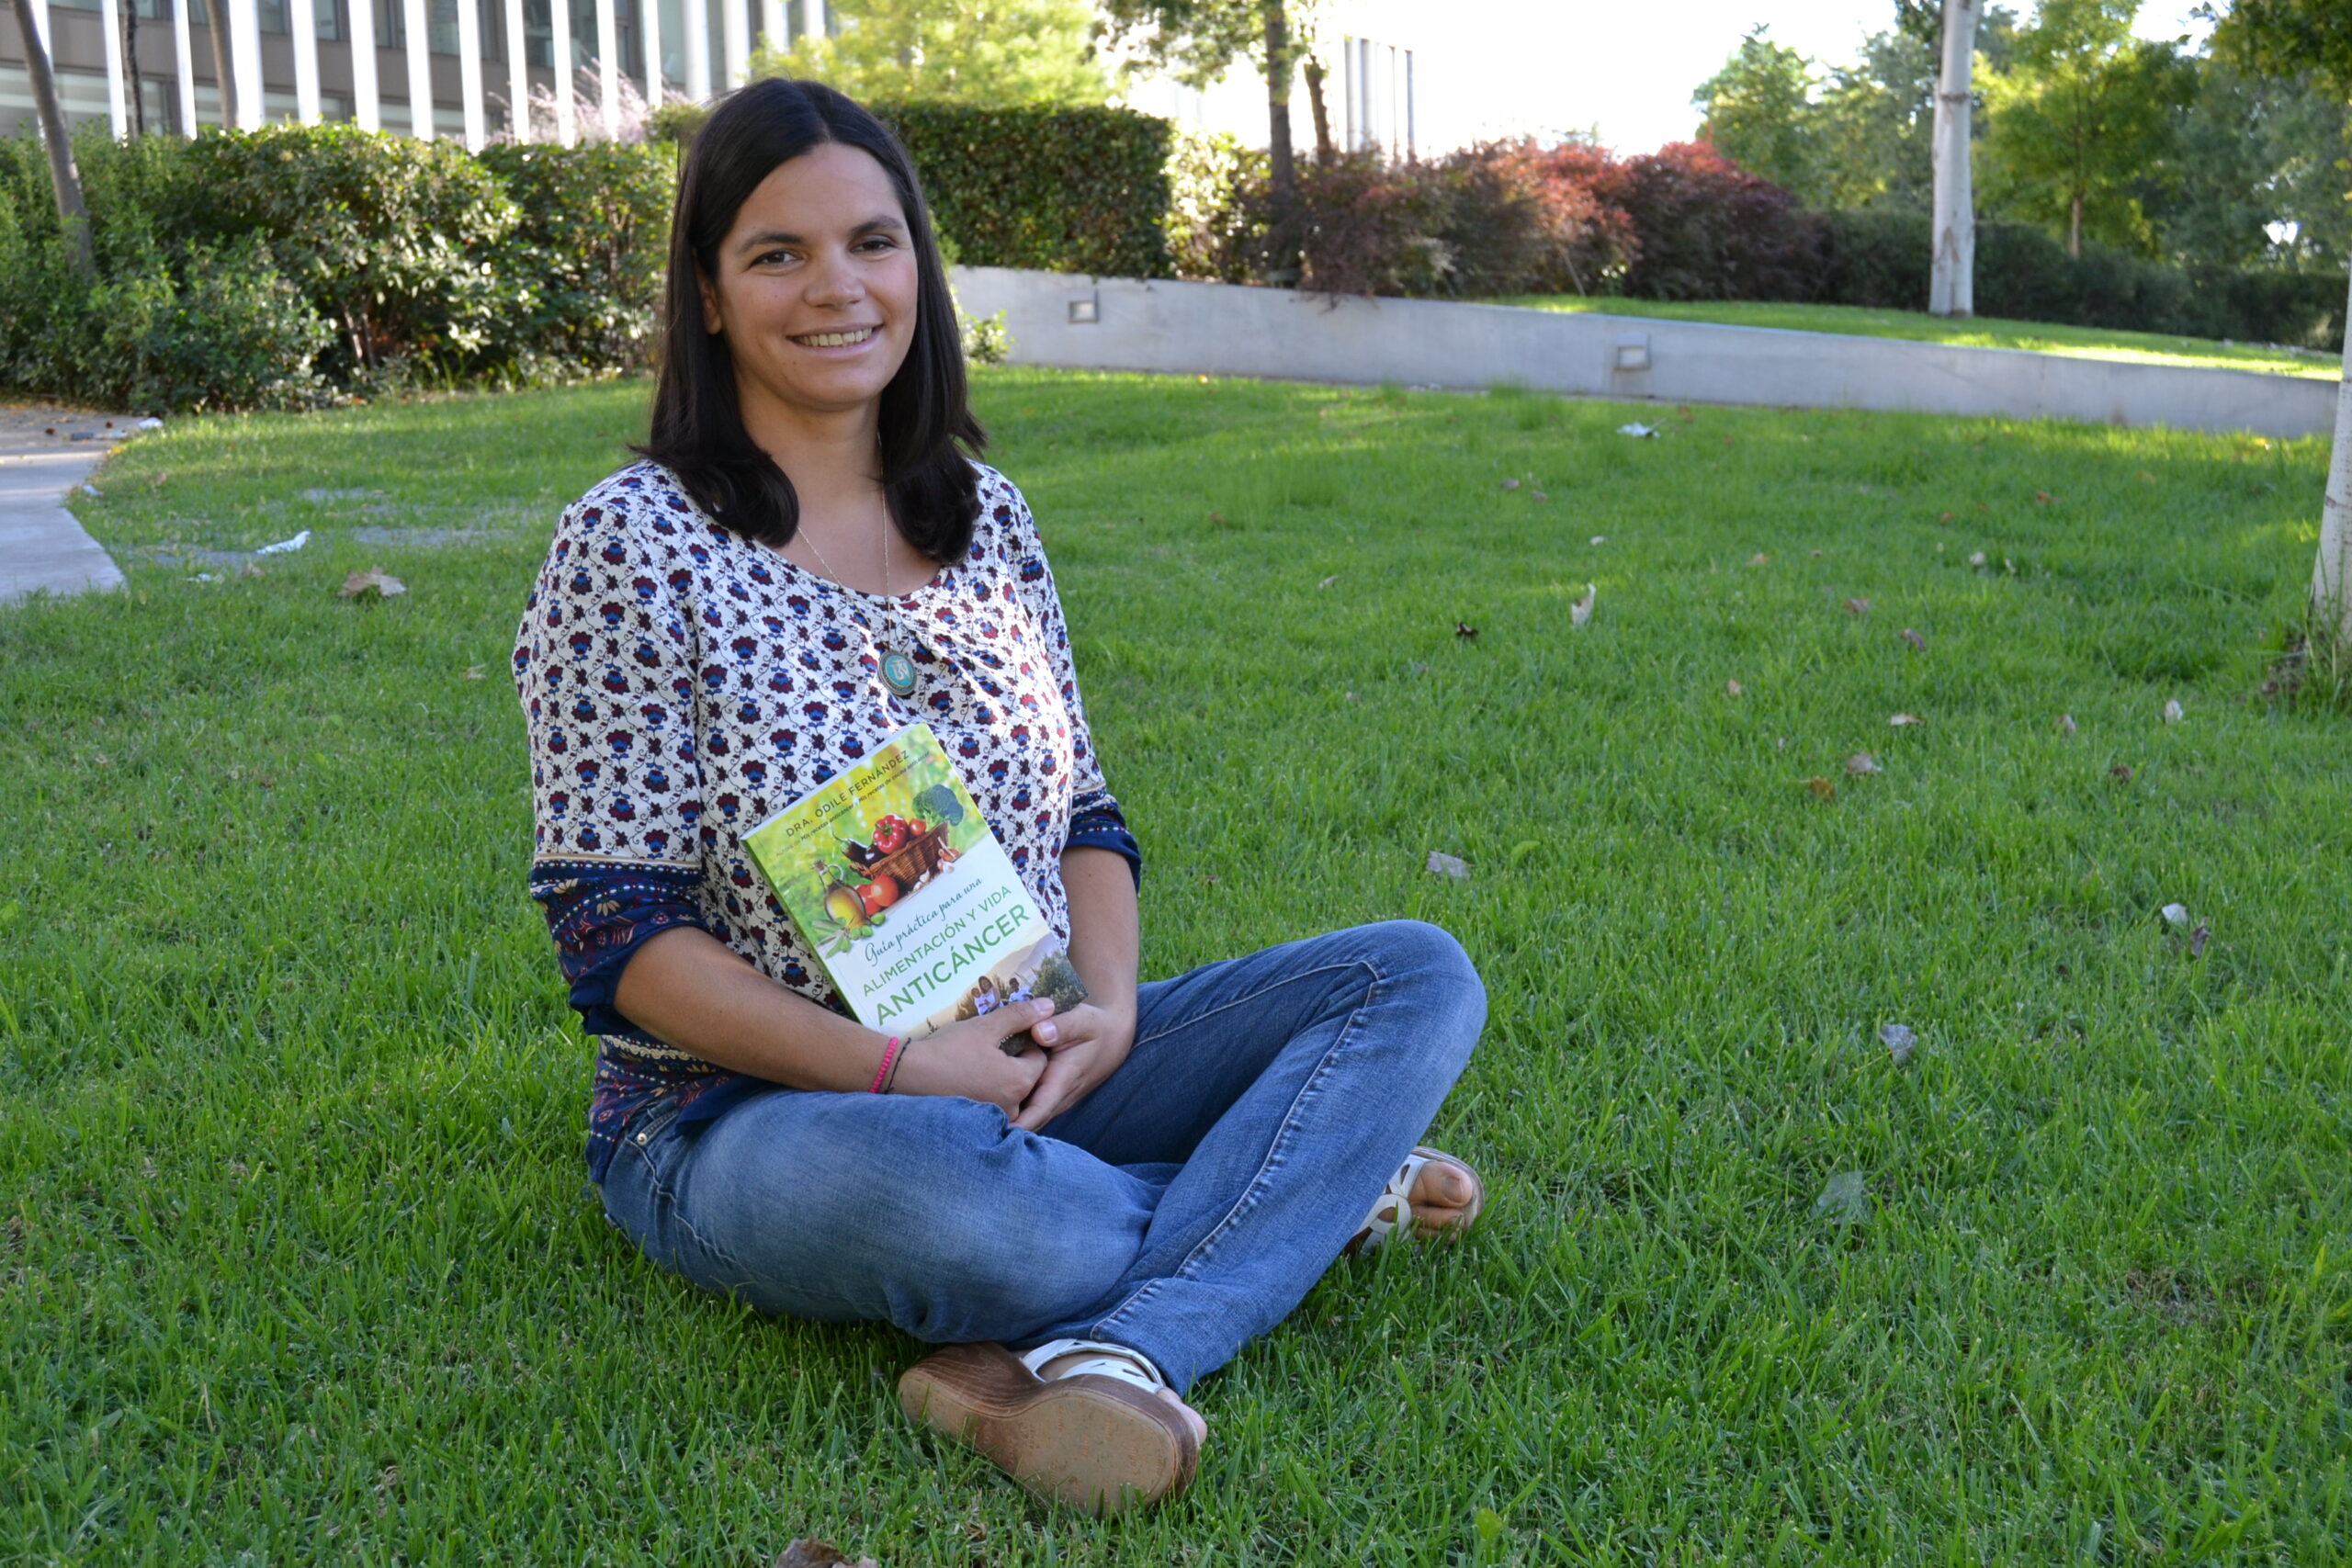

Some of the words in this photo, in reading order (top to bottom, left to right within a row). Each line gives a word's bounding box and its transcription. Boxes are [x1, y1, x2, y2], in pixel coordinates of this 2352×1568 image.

[786, 818, 813, 837] DRA.
[815, 793, 847, 818] ODILE
[848, 750, 910, 795] FERNÁNDEZ
[810, 821, 829, 836] recetas
[867, 784, 885, 798] recetas
[863, 918, 967, 998] ALIMENTACIÓN
[967, 908, 977, 921] Y
[978, 886, 1012, 912] VIDA
[865, 939, 895, 967] Guía
[895, 910, 938, 953] práctica
[938, 892, 963, 921] para
[964, 878, 983, 895] una
[875, 904, 1031, 1027] ANTICÁNCER
